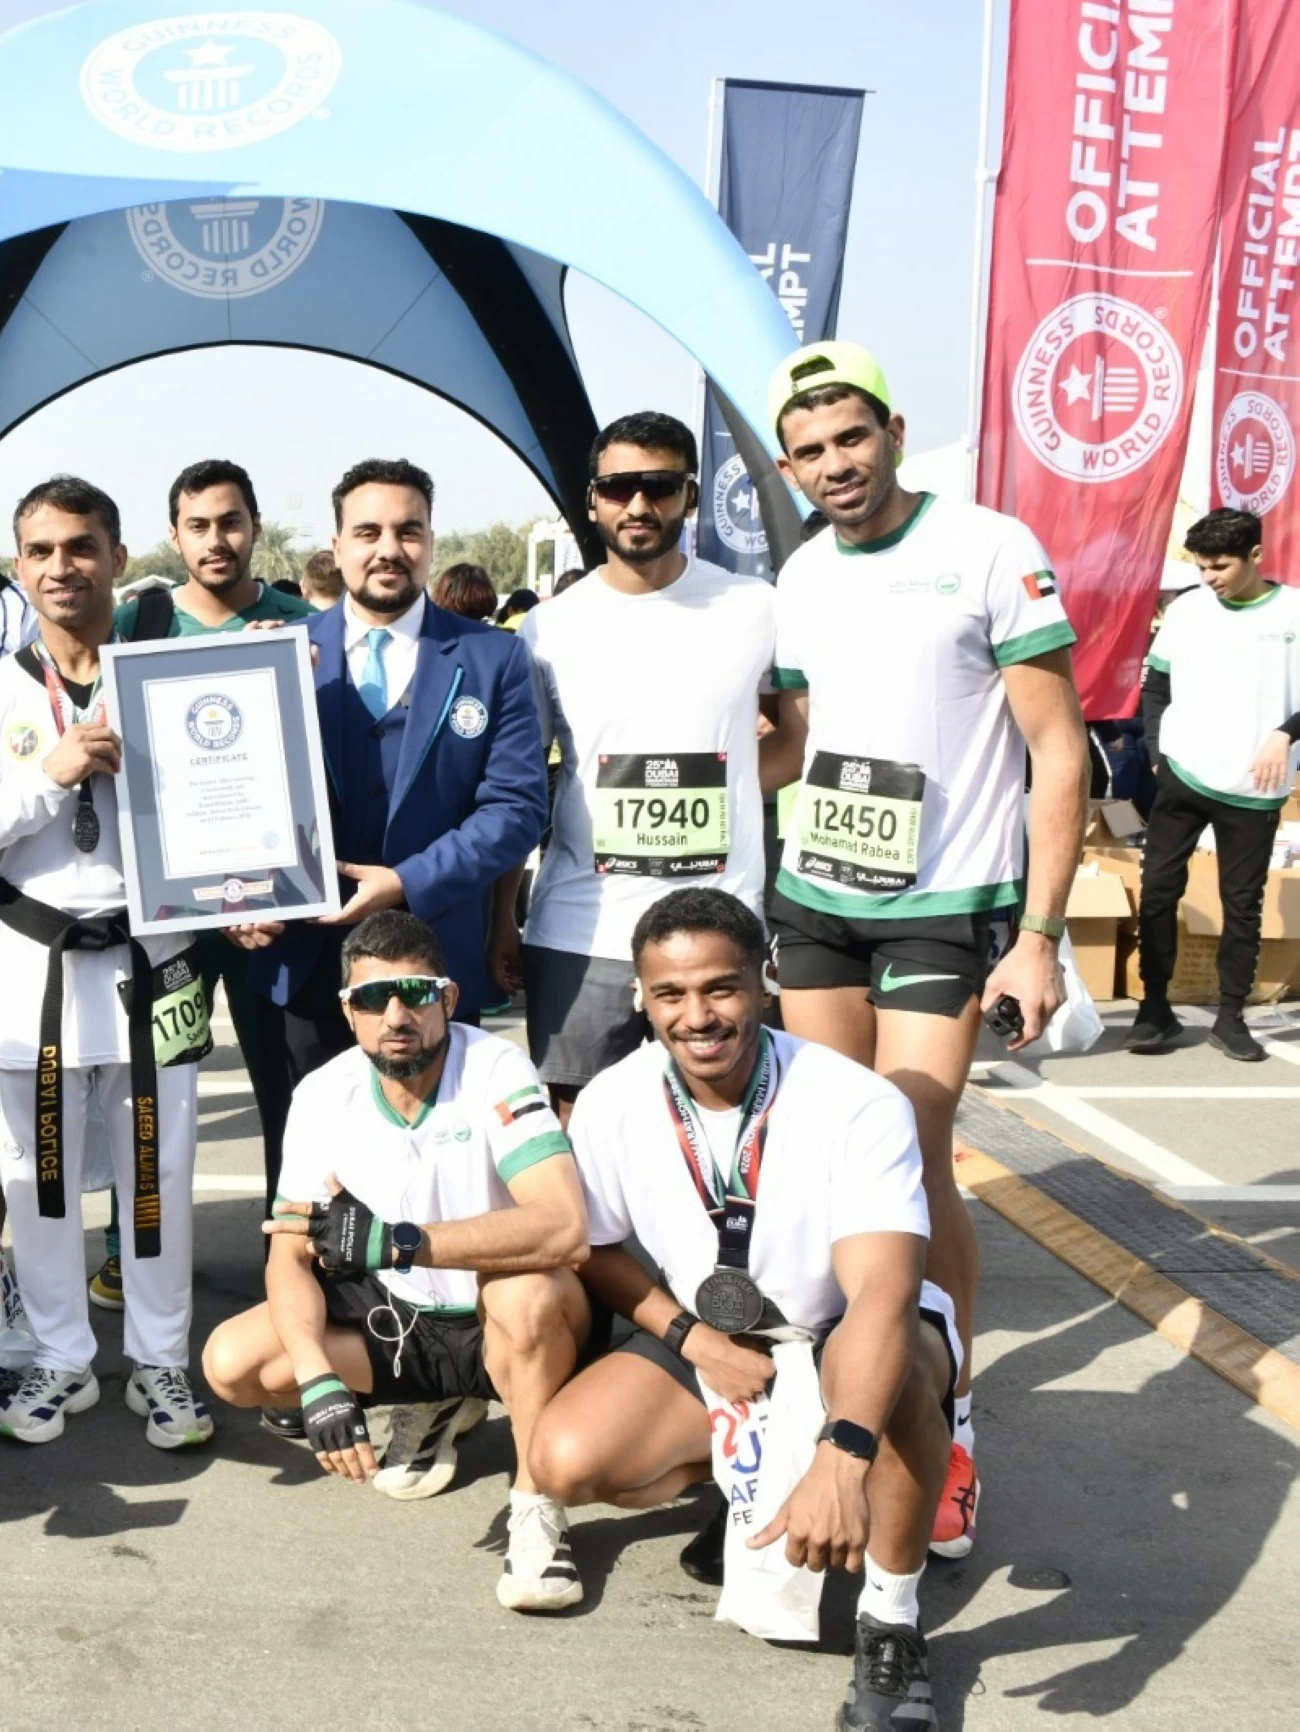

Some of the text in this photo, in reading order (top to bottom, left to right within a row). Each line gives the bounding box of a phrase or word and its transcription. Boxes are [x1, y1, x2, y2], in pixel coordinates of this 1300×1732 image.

[123, 19, 297, 52] GUINNESS
[99, 52, 322, 140] WORLD RECORDS
[1066, 0, 1121, 243] OFFICI
[1234, 127, 1286, 357] OFFICIAL
[1027, 316, 1074, 452] GUINNESS
[1083, 306, 1170, 470] WORLD RECORDS
[1240, 399, 1288, 512] WORLD RECORDS
[714, 464, 741, 537] GUINNESS
[190, 752, 249, 765] CERTIFICATE
[645, 769, 679, 778] DUBAI
[613, 797, 710, 829] 17940
[813, 798, 897, 841] 12450
[637, 833, 688, 846] Hussain
[810, 832, 900, 860] Mohamad Rabea
[137, 1096, 154, 1190] SAEED ALMAS
[345, 1232, 355, 1262] POLICE
[705, 1275, 753, 1293] FINISHER
